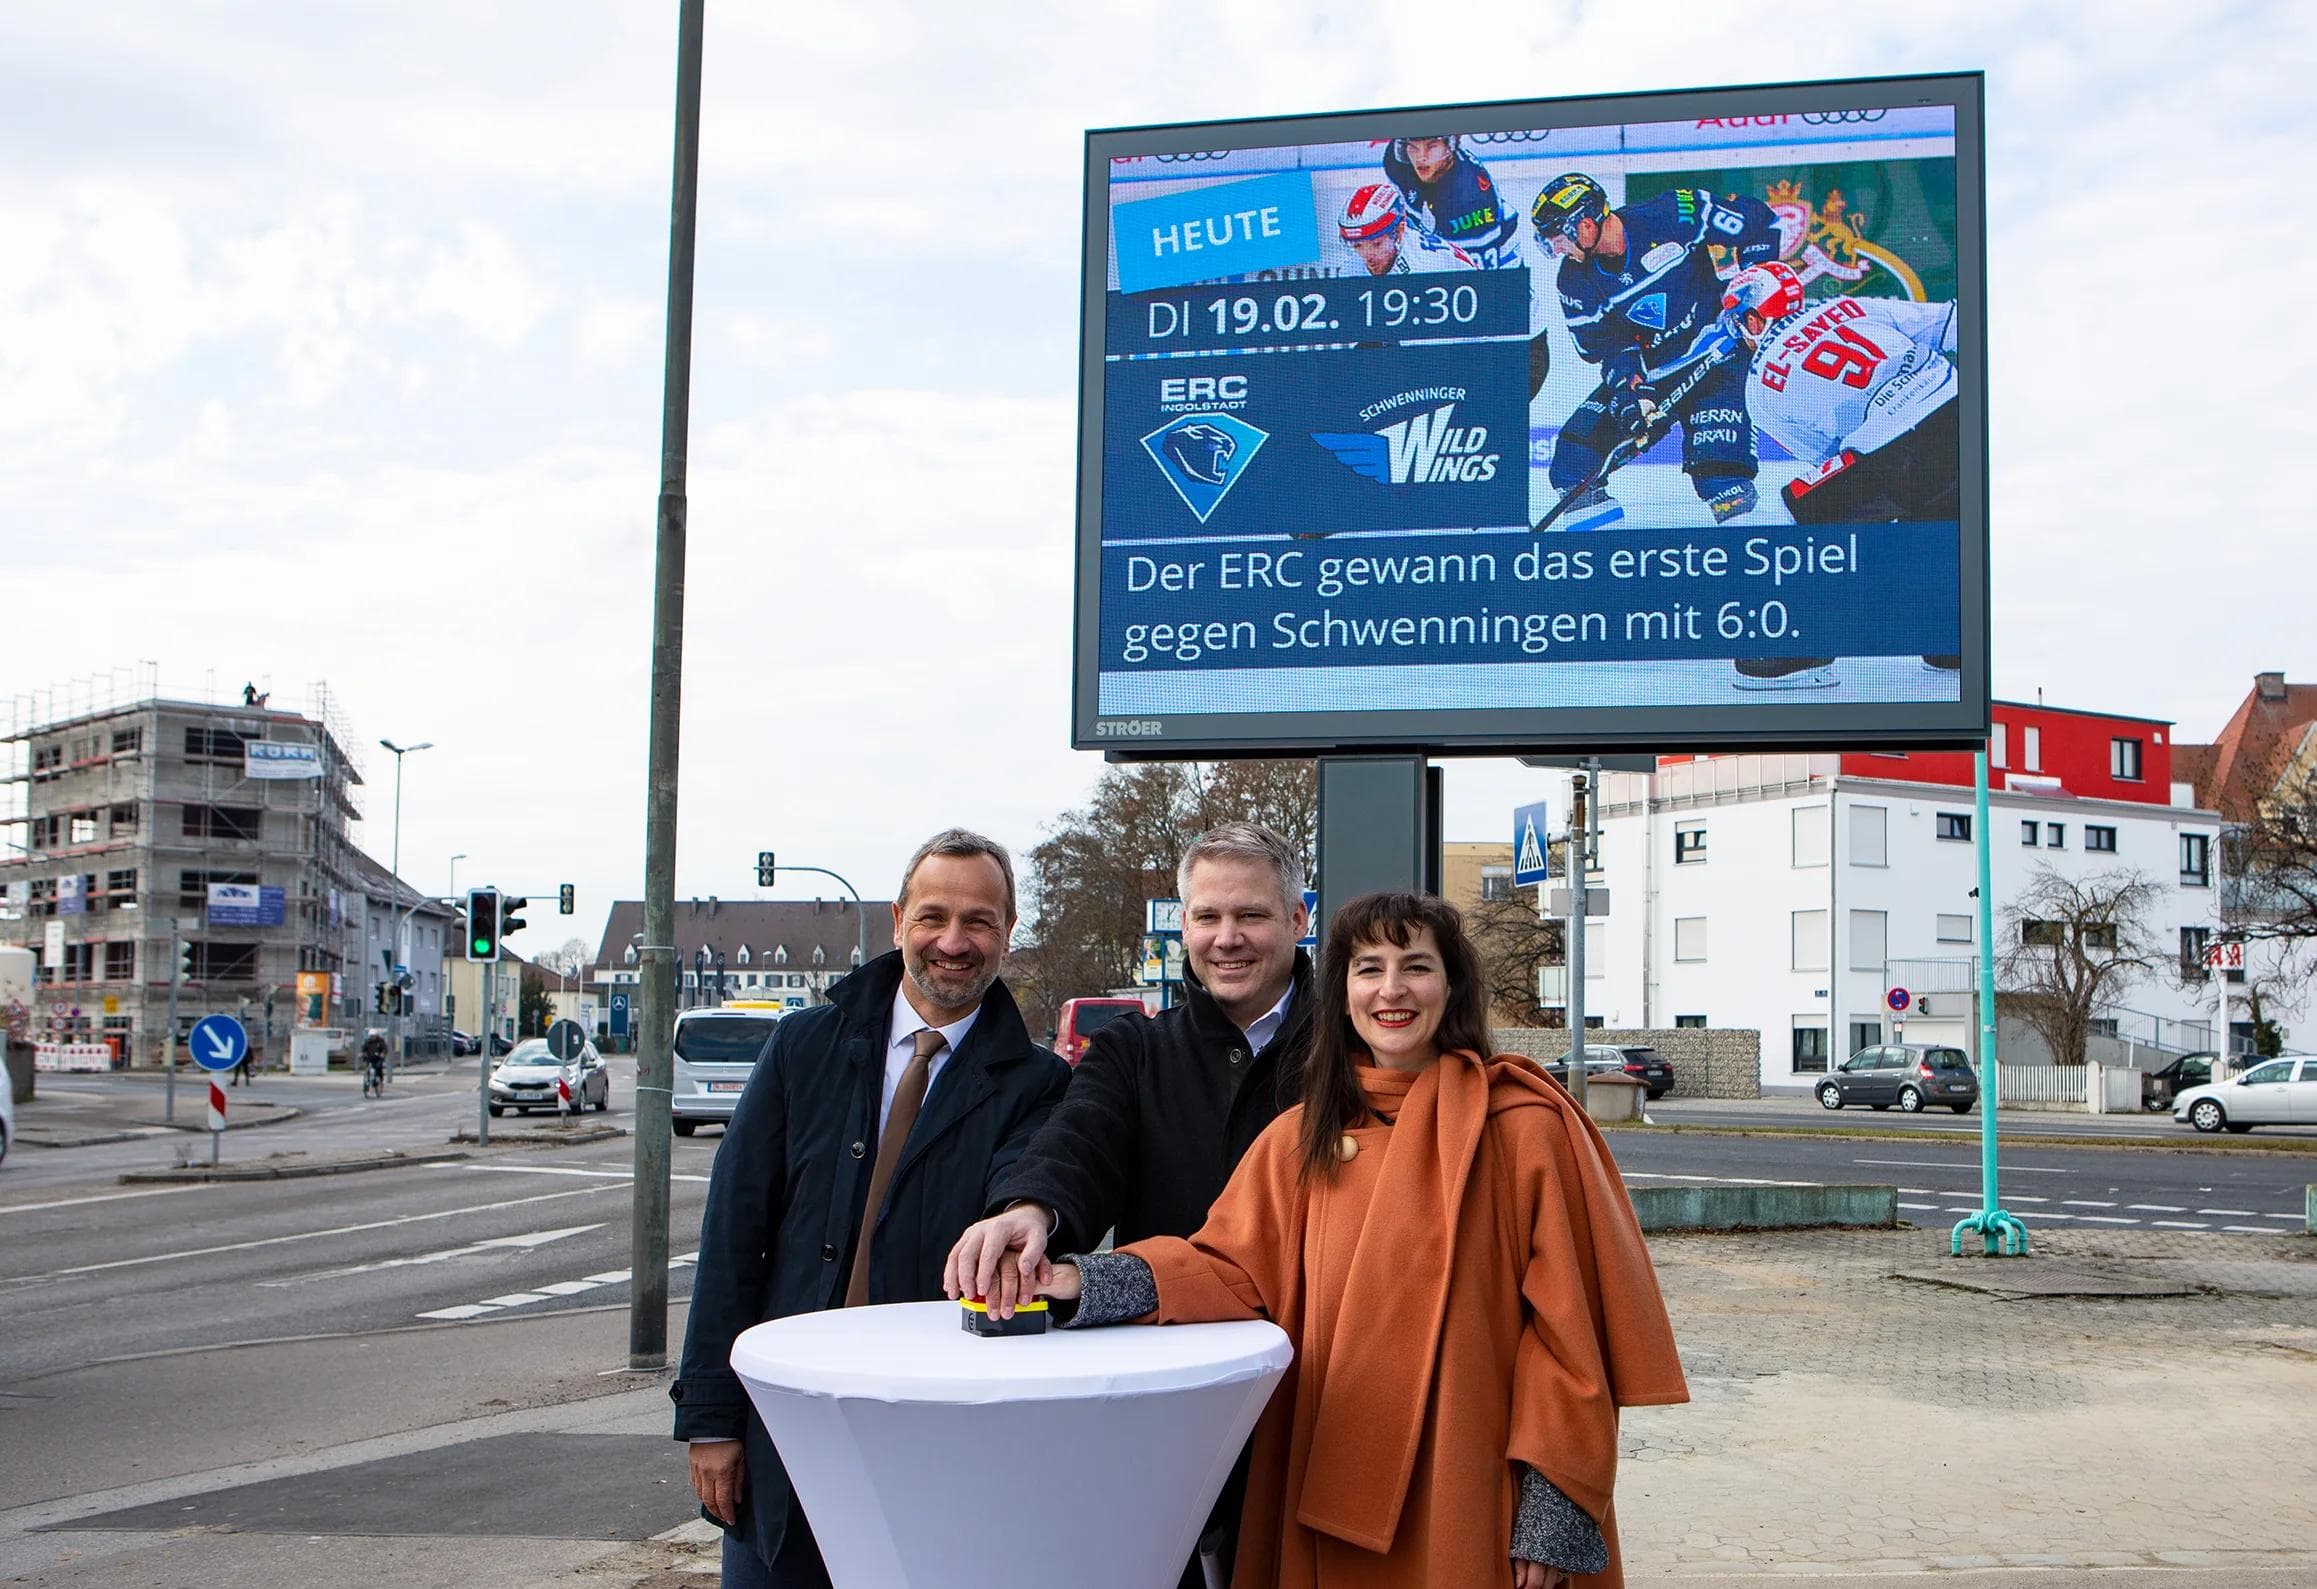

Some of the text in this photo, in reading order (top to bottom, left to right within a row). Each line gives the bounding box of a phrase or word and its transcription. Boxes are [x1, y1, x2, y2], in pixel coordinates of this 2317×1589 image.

[1152, 206, 1281, 257] HEUTE
[1451, 208, 1495, 234] JUKE
[1149, 285, 1479, 338] DI 19.02. 19:30
[1801, 324, 1888, 390] 91
[1160, 375, 1248, 402] ERC
[1359, 386, 1466, 422] SCHWENNINGER
[1160, 400, 1247, 412] INGOLSTADT
[1689, 408, 1744, 425] HERRN
[1692, 428, 1738, 446] BRÄU
[1127, 534, 1857, 597] Der ERC gewann das erste Spiel
[1122, 600, 1801, 663] gegen Schwenningen mit 6:0.
[1095, 719, 1163, 736] STRÖER
